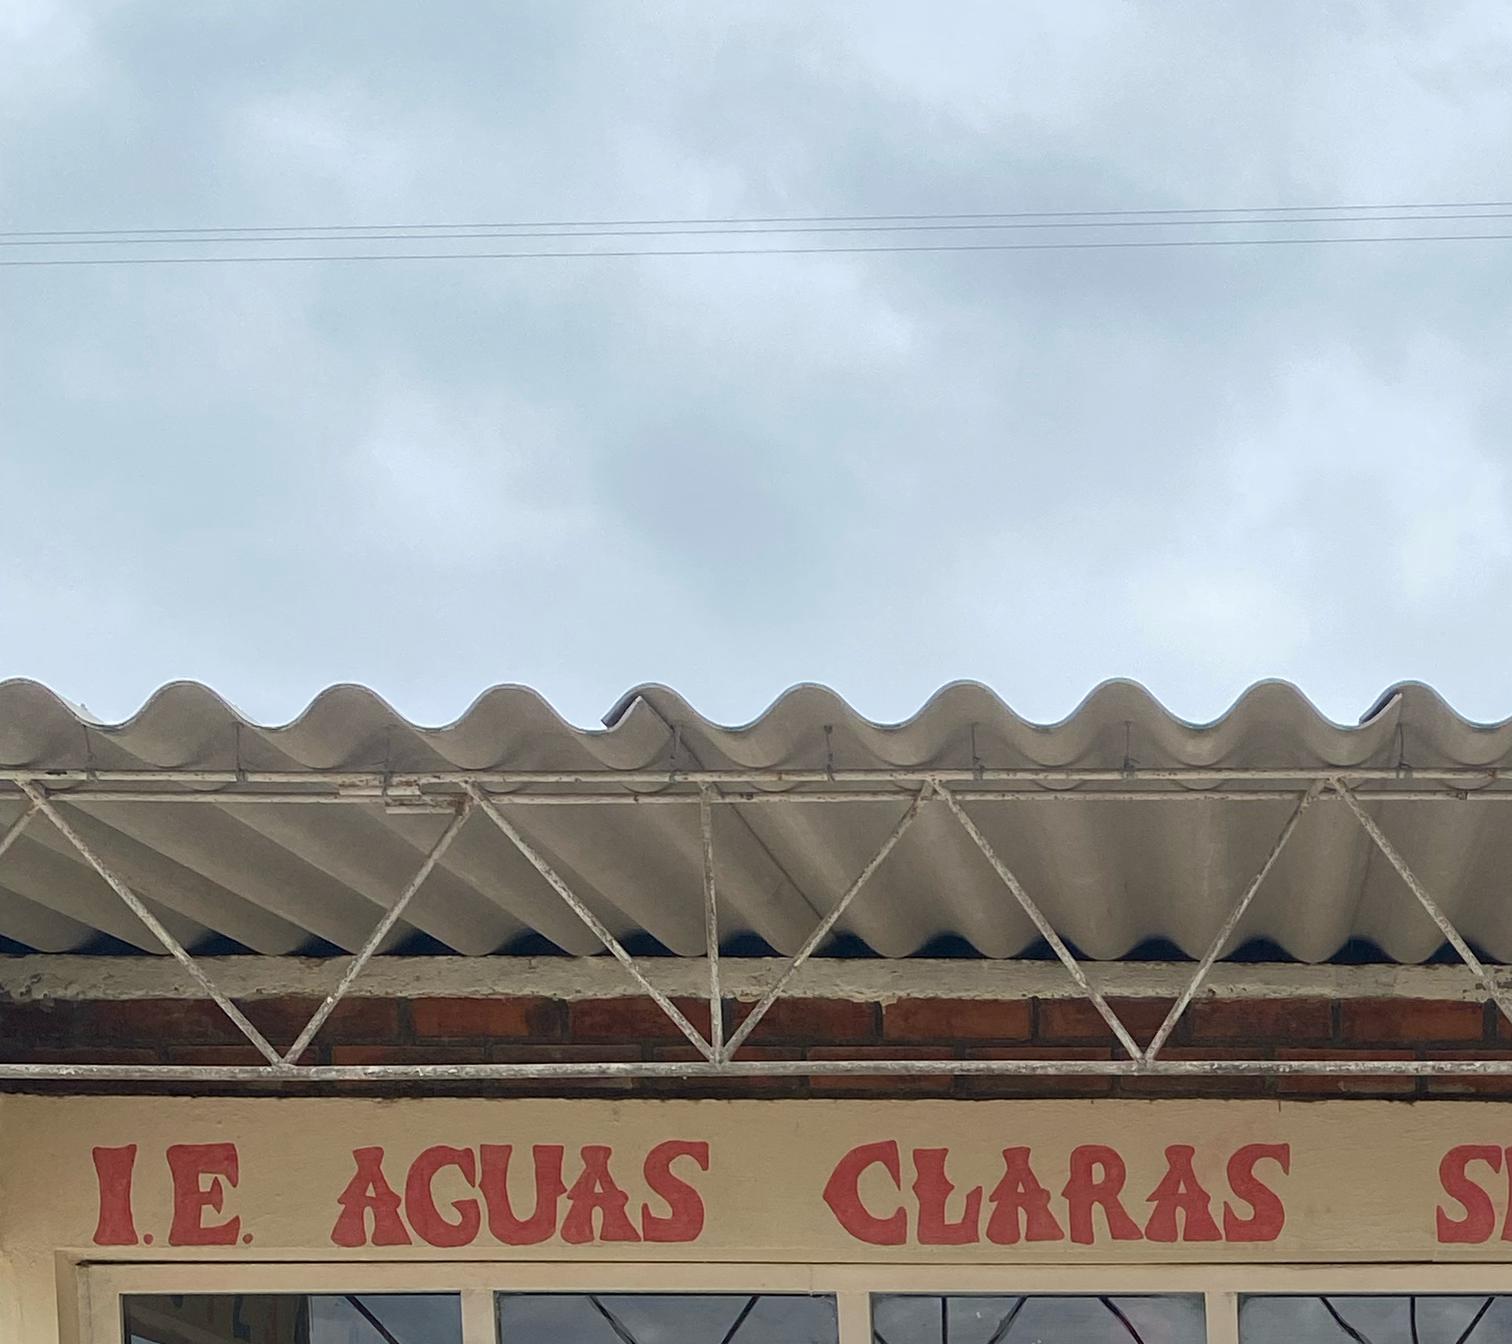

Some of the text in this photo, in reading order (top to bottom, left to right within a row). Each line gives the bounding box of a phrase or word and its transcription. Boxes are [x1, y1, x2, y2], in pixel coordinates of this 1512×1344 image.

[92, 1142, 254, 1247] I.E.
[330, 1140, 711, 1247] AGUAS
[822, 1140, 1291, 1246] CLARAS
